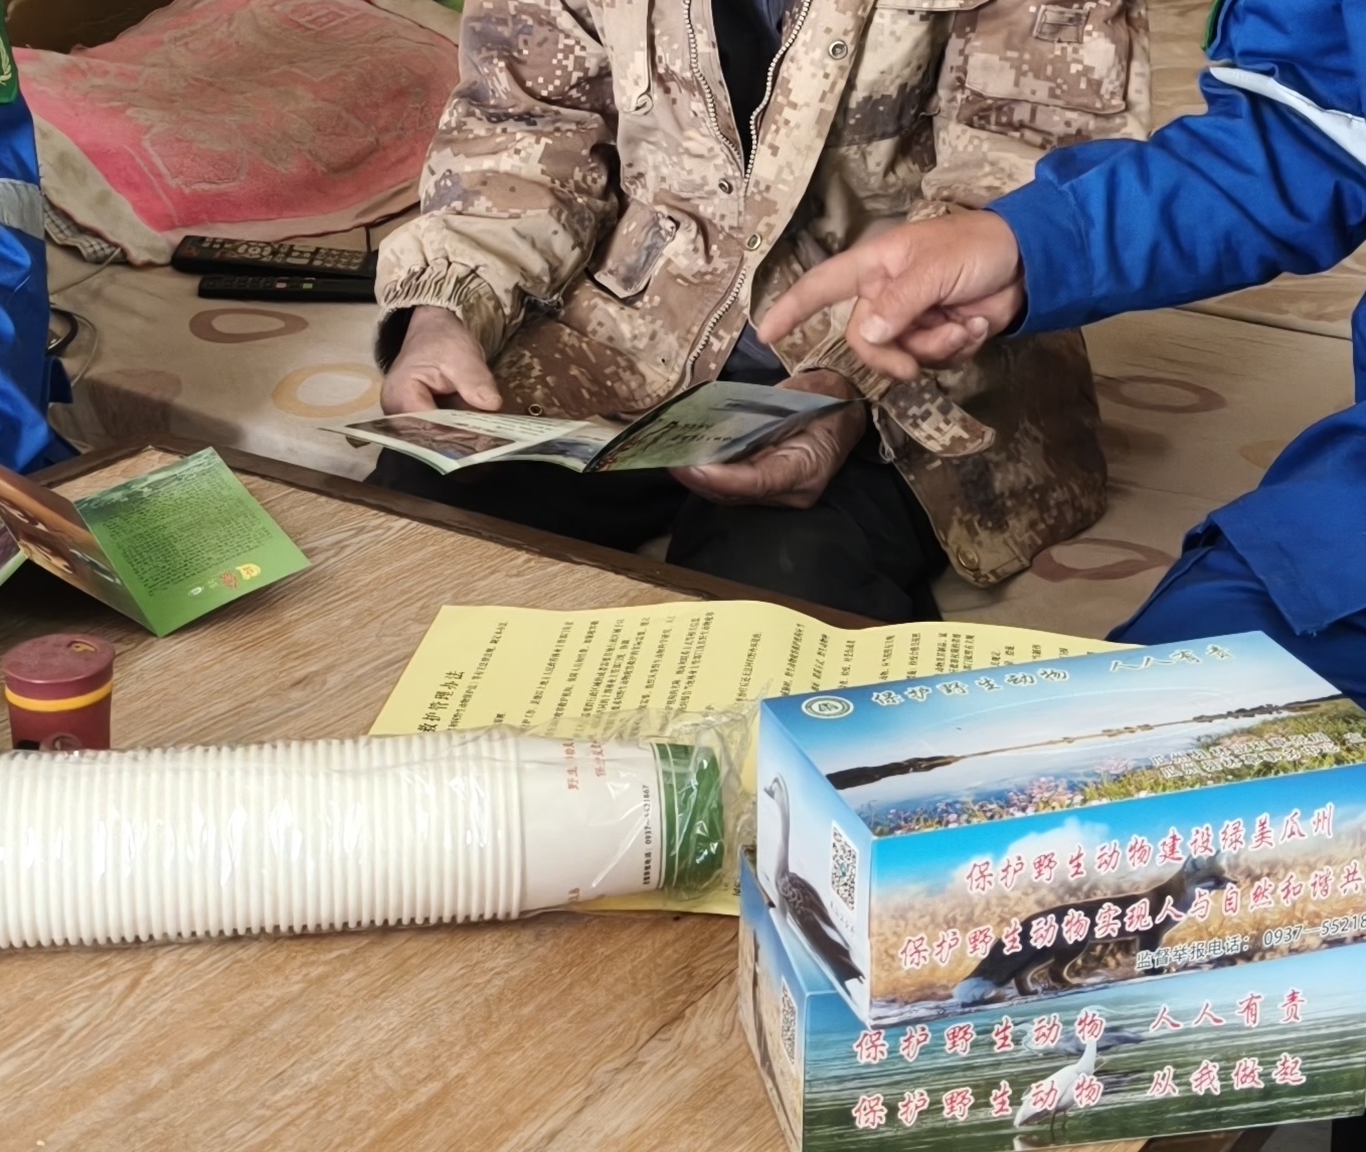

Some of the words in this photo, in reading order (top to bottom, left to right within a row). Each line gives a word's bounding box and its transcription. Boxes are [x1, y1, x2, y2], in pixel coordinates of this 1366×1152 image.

[871, 667, 1069, 707] 保护野生动物
[1109, 644, 1234, 672] 人人有责
[965, 802, 1333, 895] 保护野生动物建设绿美瓜州
[853, 1008, 1107, 1065] 保护野生动物
[1149, 987, 1306, 1032] 人人有责
[851, 1073, 1105, 1129] 保护野生动物
[1147, 1052, 1307, 1098] 从我做起
